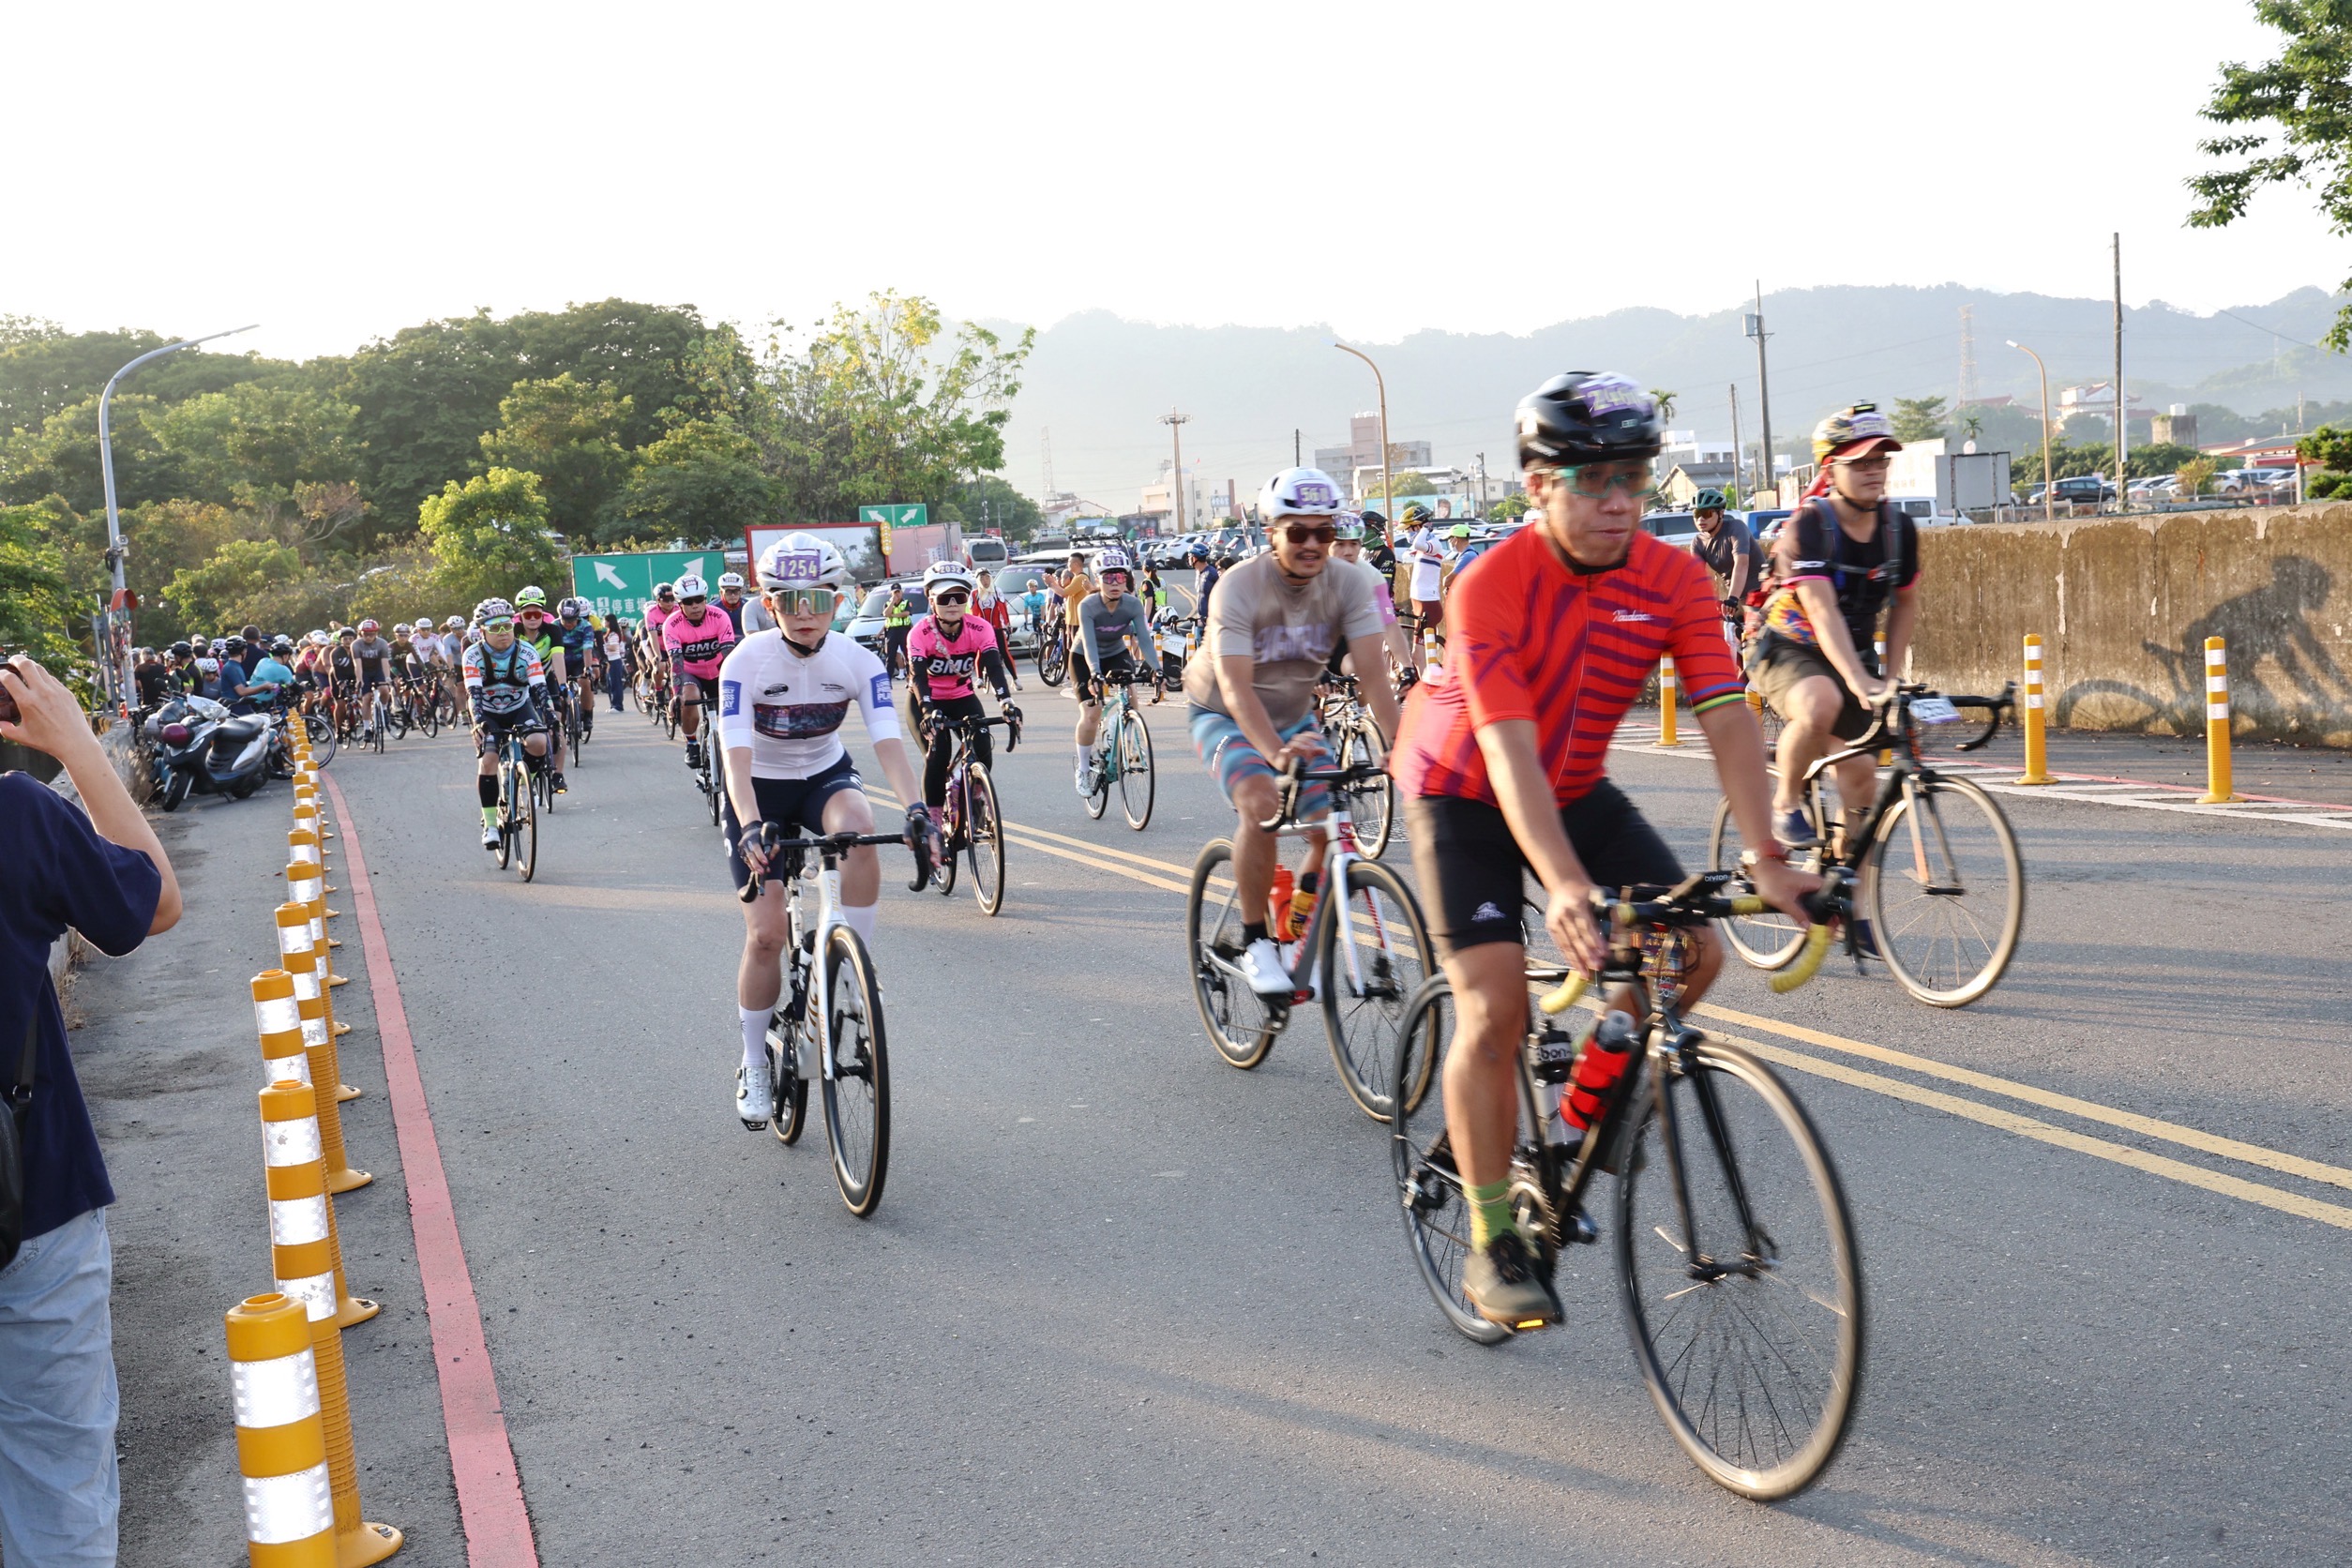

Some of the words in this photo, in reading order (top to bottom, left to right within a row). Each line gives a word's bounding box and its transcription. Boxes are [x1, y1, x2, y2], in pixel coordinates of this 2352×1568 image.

[779, 559, 819, 578] 1254
[940, 565, 962, 574] 2032
[670, 615, 684, 628] BMG
[708, 611, 723, 620] BMG
[965, 621, 985, 632] BMG
[685, 640, 720, 654] BMG
[928, 656, 974, 674] BMG
